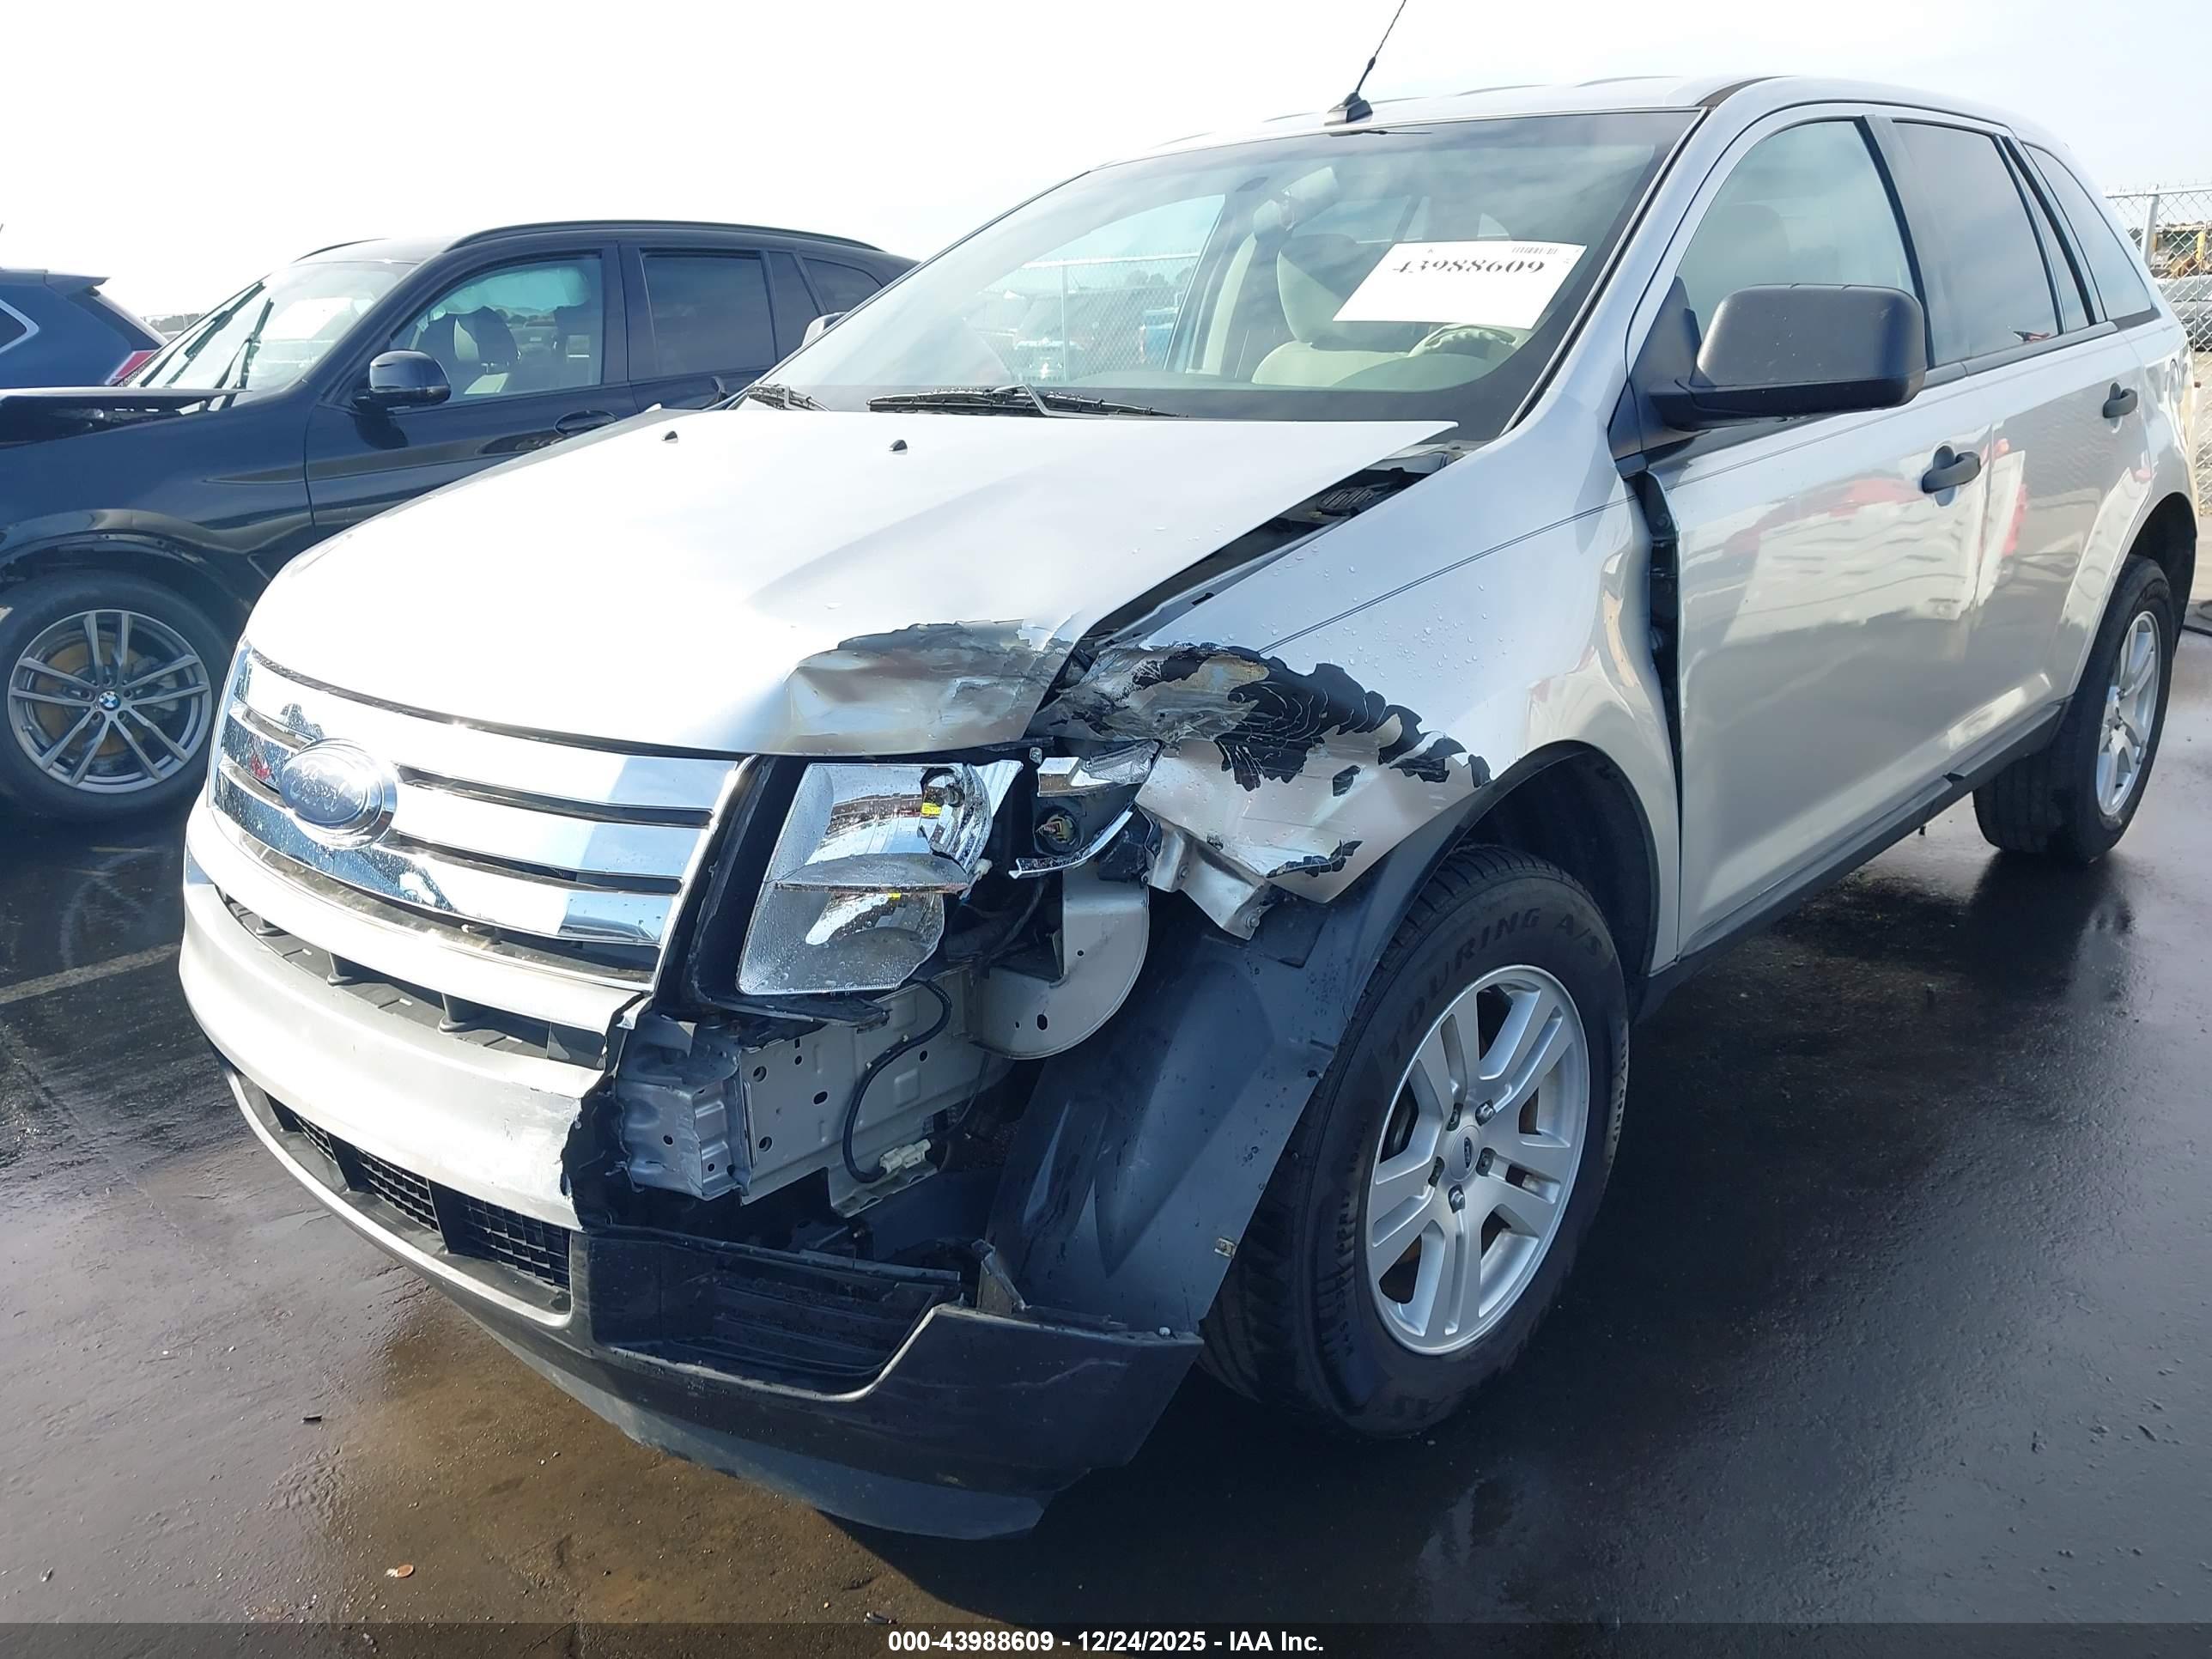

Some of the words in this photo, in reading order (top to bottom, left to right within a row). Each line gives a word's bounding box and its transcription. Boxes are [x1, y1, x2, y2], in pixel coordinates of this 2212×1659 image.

[1392, 259, 1545, 273] 43988609
[1382, 908, 1541, 1064] TOURING
[1554, 913, 1602, 957] A/S
